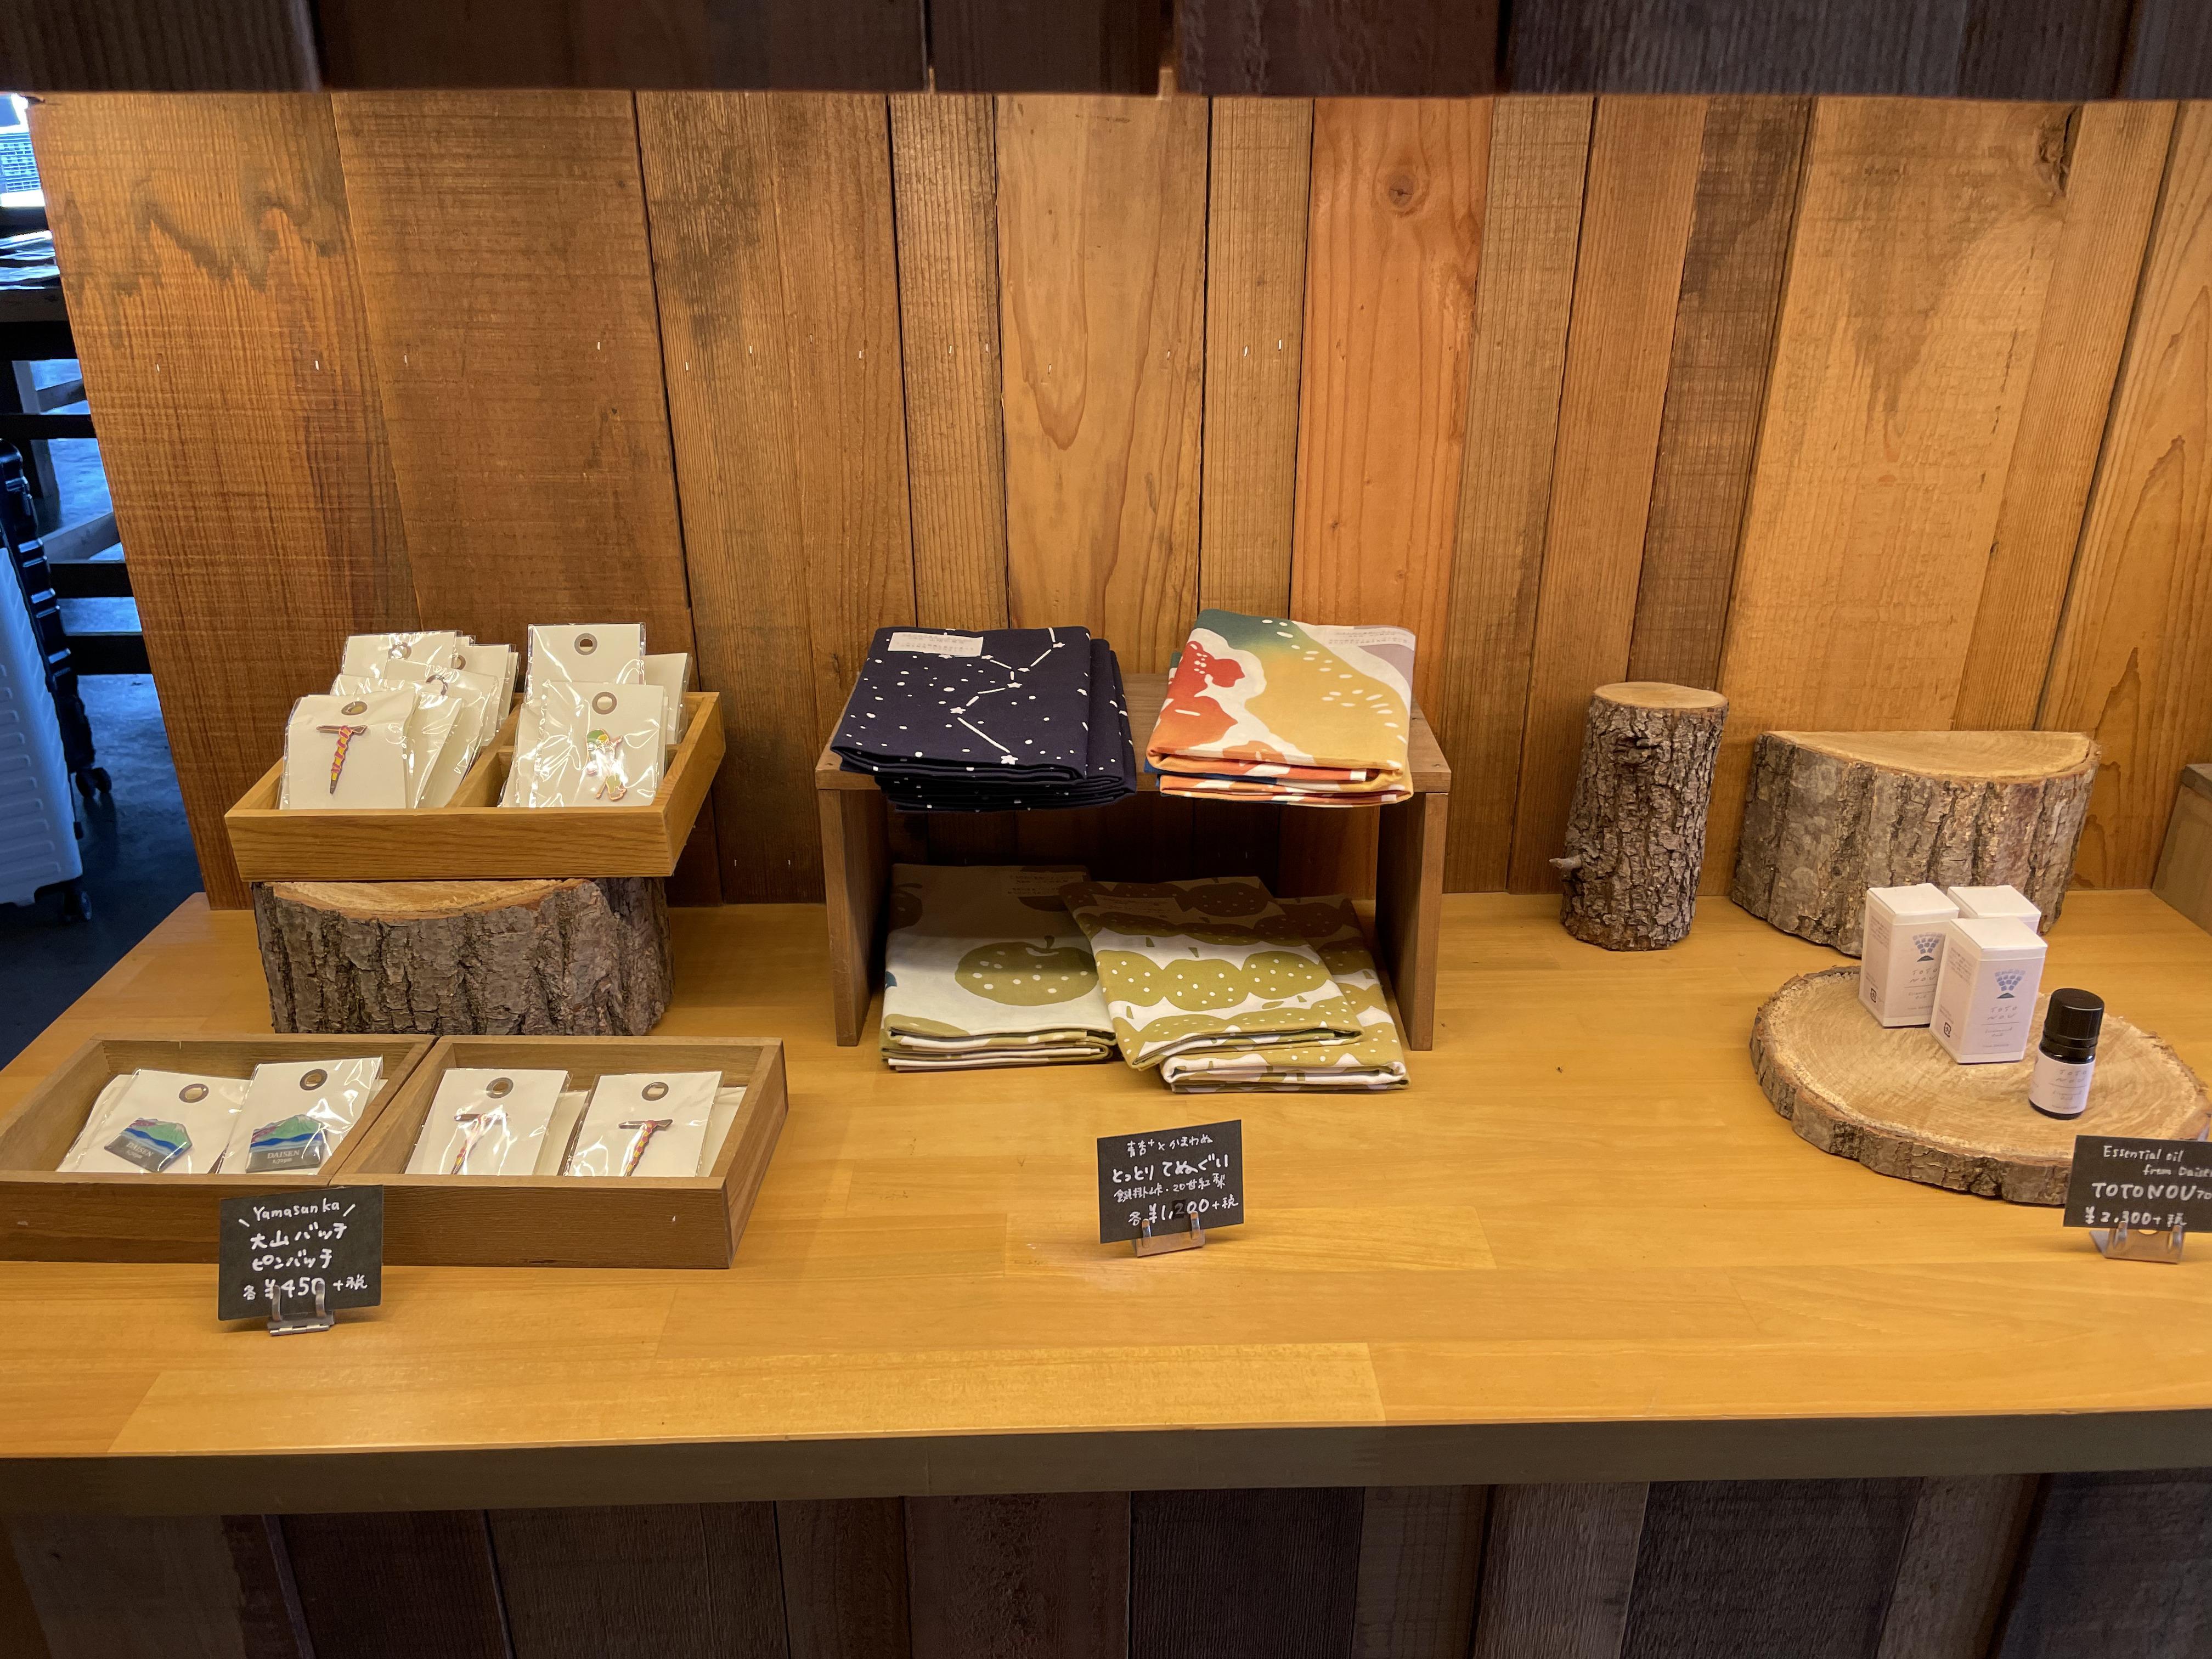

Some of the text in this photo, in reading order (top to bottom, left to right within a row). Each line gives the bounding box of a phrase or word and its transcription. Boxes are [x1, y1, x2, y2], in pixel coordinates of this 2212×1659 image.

[267, 1149, 300, 1159] DAISEN
[2103, 1145, 2184, 1163] Essential oil
[1112, 1153, 1228, 1183] とっとり てぬぐい
[2091, 1182, 2198, 1201] TOTONOU
[252, 1198, 340, 1221] Yamasanka
